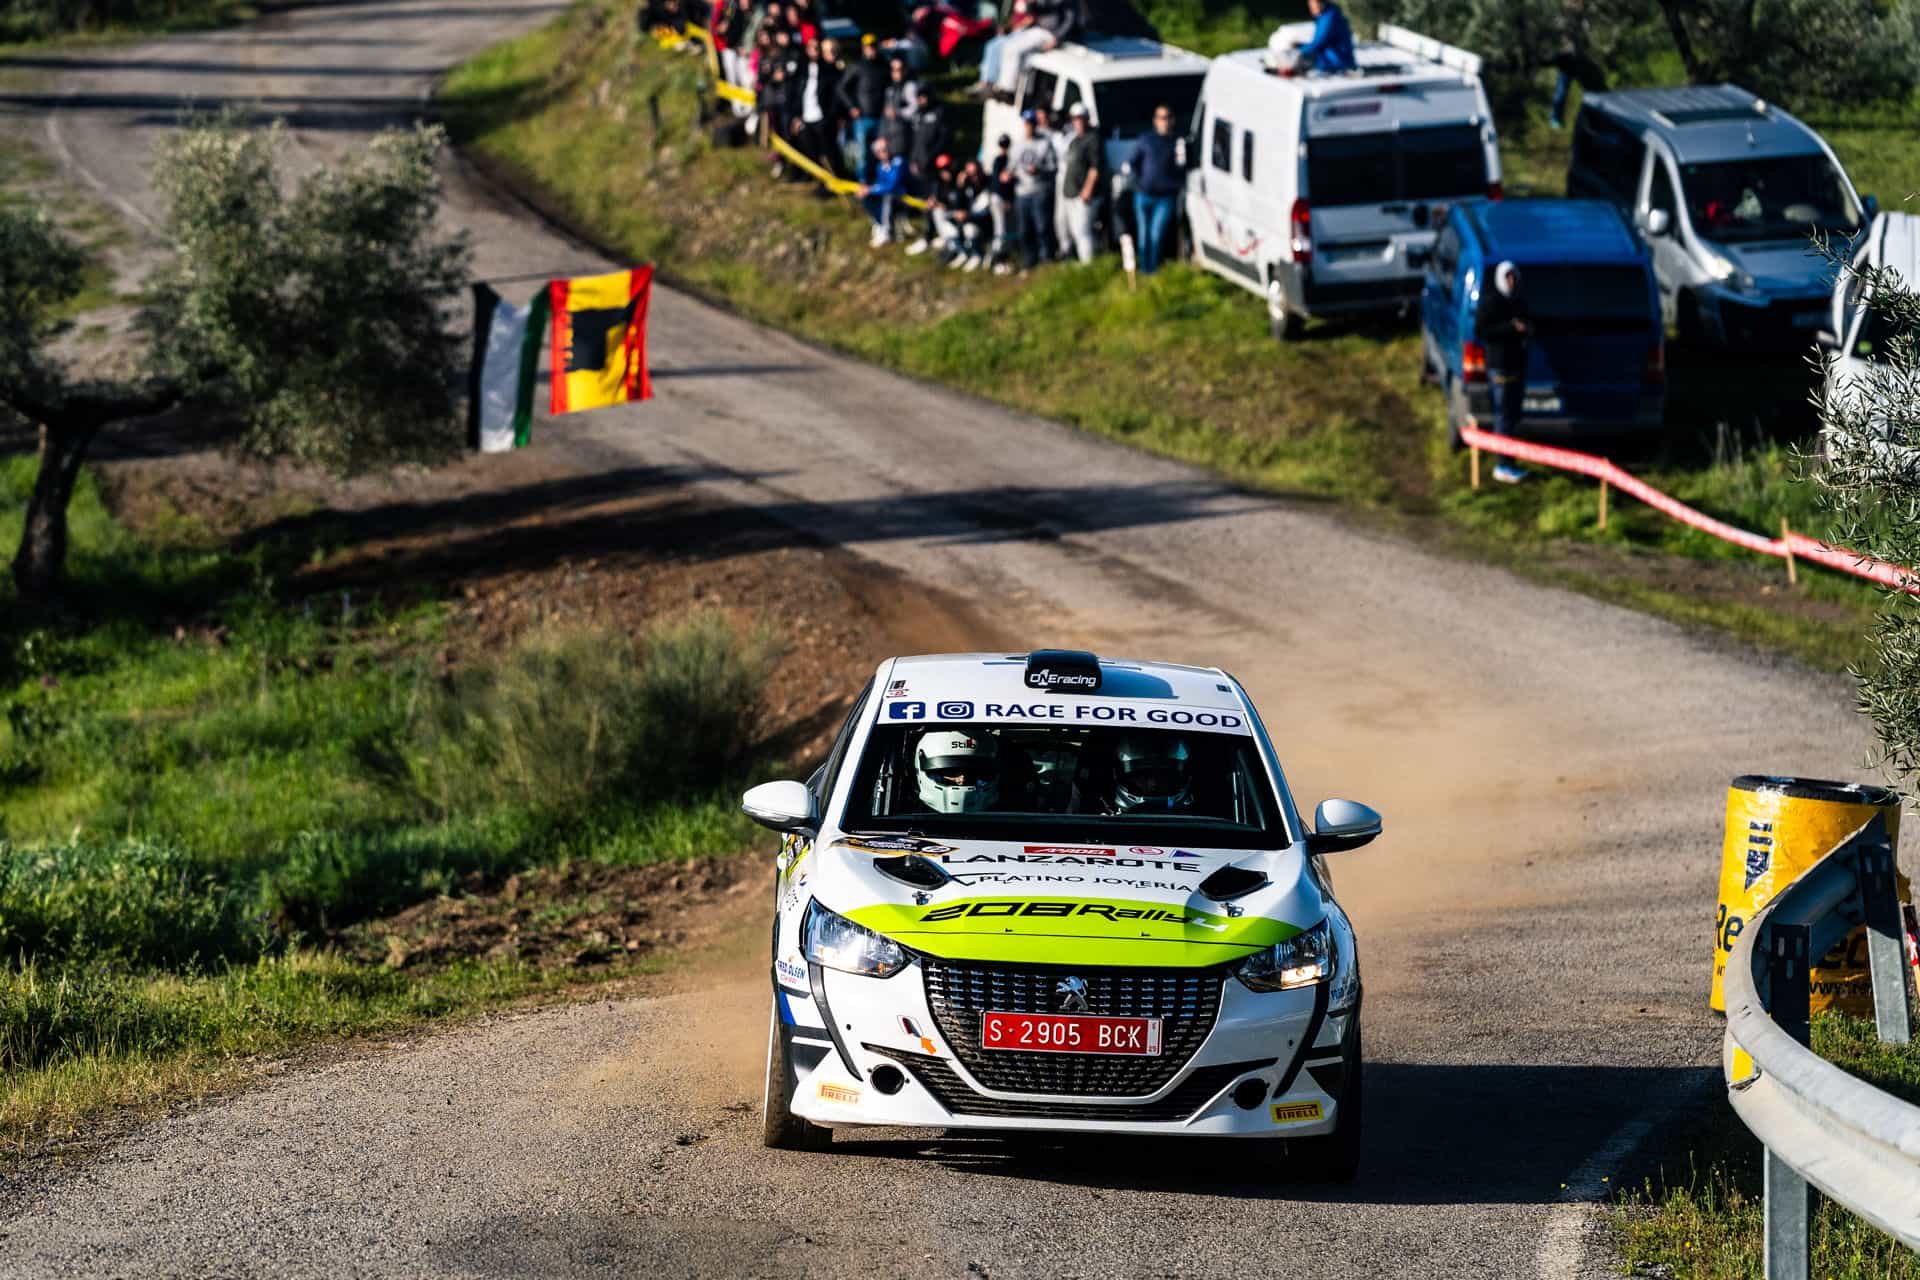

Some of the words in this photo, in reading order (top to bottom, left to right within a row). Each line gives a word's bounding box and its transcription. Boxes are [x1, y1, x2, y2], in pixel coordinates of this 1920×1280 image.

[986, 703, 1065, 719] RACE
[1075, 705, 1137, 721] FOR
[1146, 709, 1241, 728] GOOD
[942, 854, 1200, 873] LANZAROTE
[979, 874, 1084, 884] PLATINO
[1020, 1020, 1081, 1046] 2905
[1099, 1024, 1141, 1048] BCK
[820, 1085, 861, 1104] PIRELLI
[1275, 1103, 1319, 1120] PIRELLI
